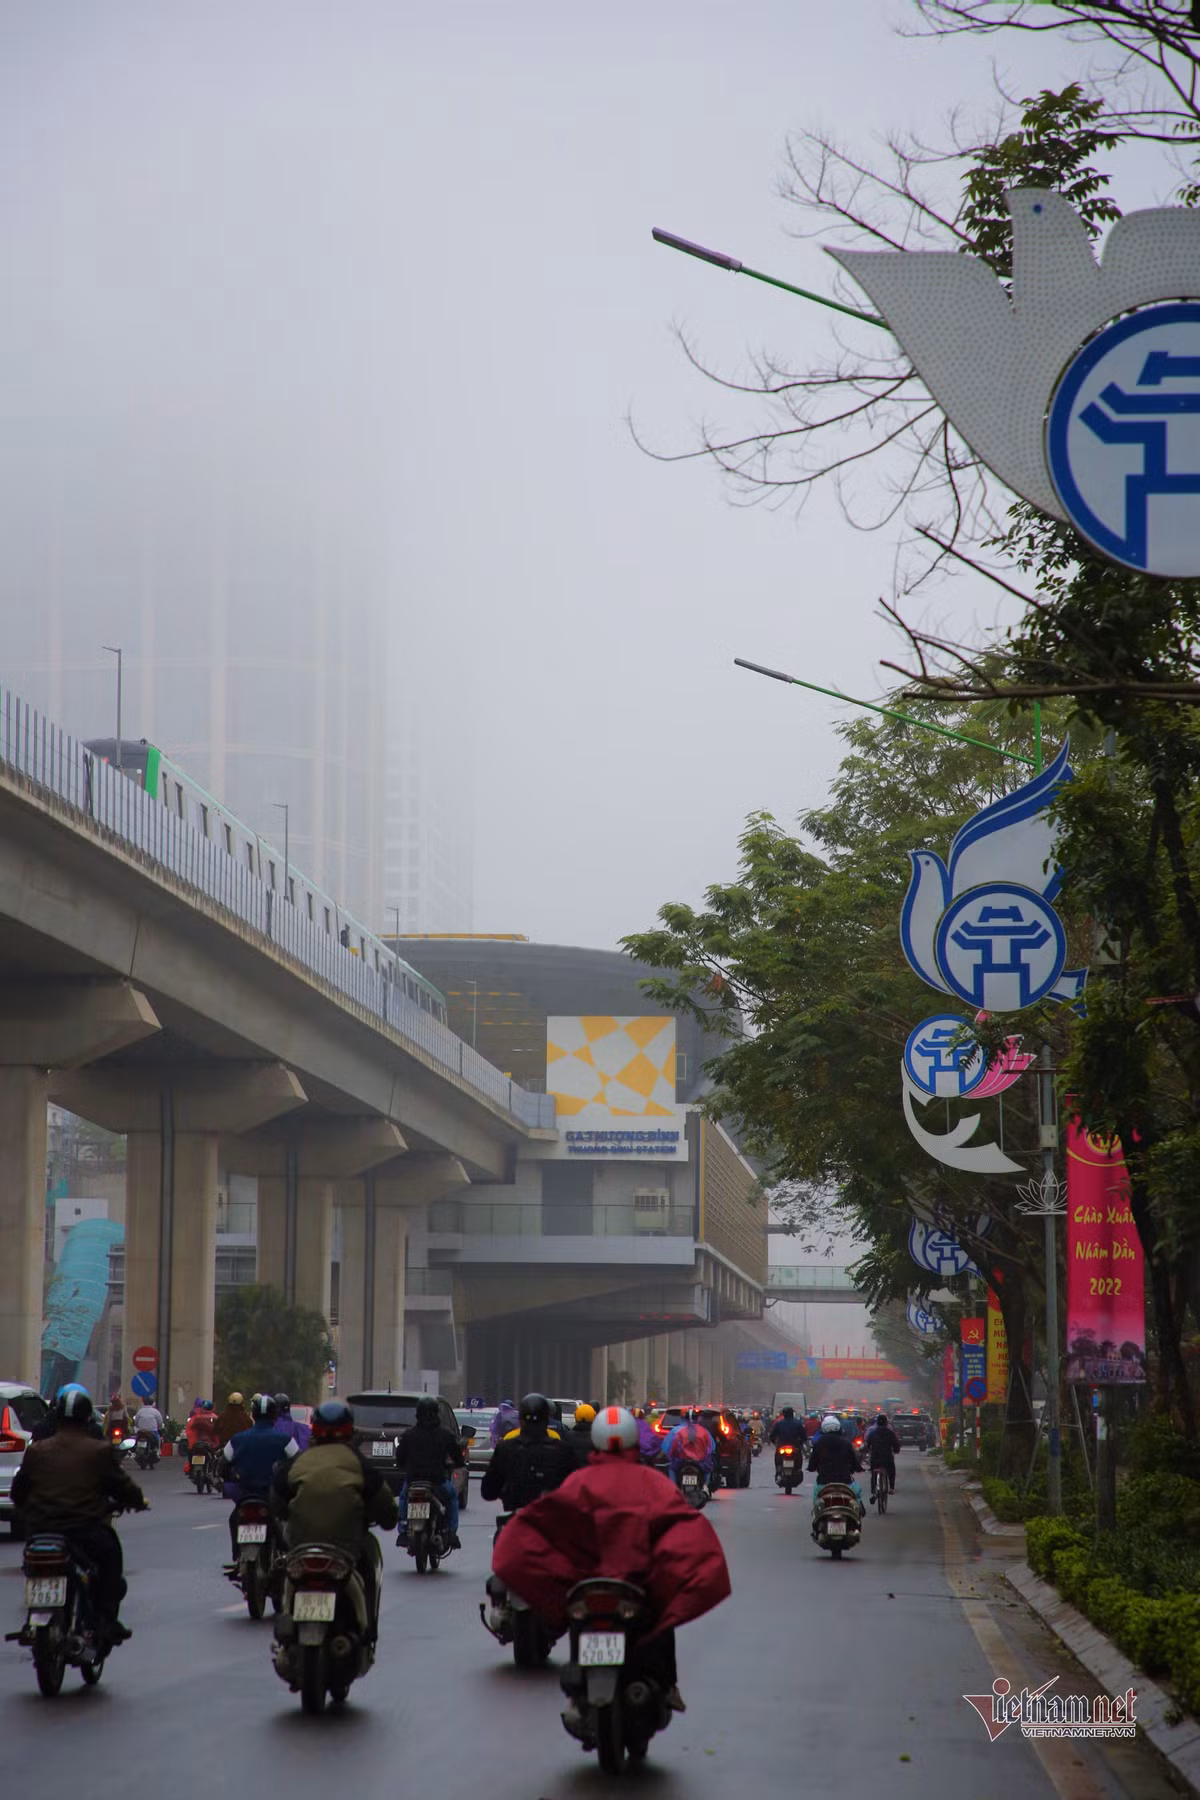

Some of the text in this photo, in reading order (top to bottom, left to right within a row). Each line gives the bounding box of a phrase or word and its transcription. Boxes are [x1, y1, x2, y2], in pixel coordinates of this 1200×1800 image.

[1074, 1205, 1136, 1225] Chào Xuân
[1076, 1237, 1135, 1260] Nhâm Dần
[1089, 1277, 1122, 1296] 2022
